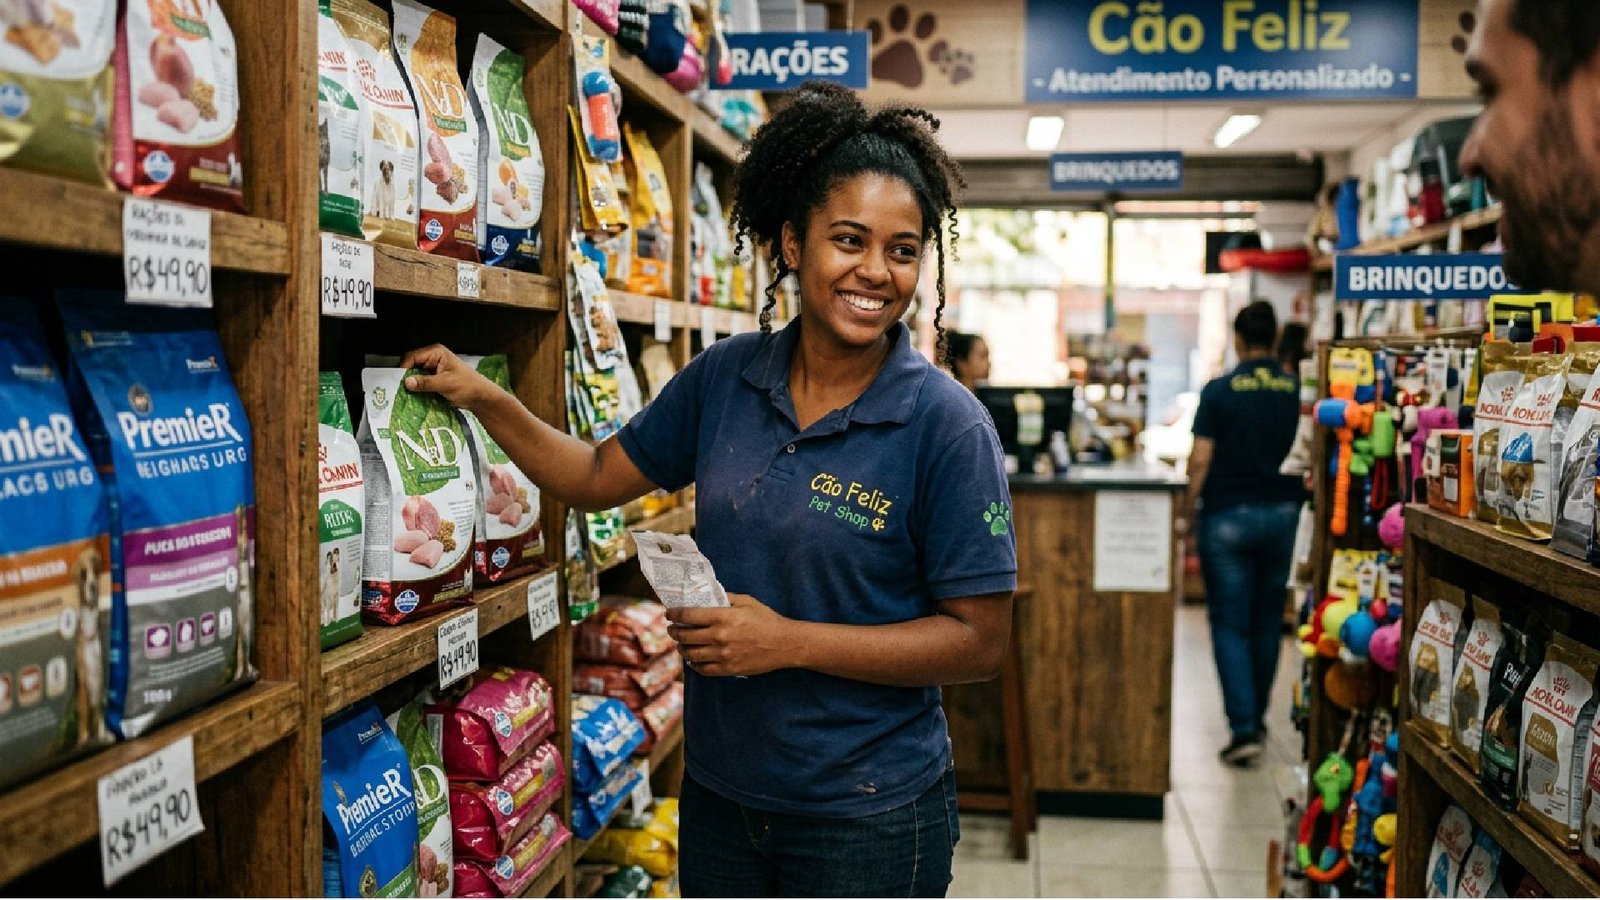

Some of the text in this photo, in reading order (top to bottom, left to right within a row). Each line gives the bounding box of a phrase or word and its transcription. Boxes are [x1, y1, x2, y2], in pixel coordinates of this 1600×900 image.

[1087, 0, 1351, 56] Cão Feliz
[732, 40, 849, 83] RAÇÕES
[1048, 67, 1212, 94] Atendimento
[1216, 62, 1395, 92] Personalizado
[1054, 159, 1179, 184] BRINQUEDOS
[129, 255, 208, 297] R$49,90
[323, 275, 372, 310] R$49,90
[1349, 264, 1519, 296] BRINQUEDO
[117, 402, 244, 450] PremieR
[808, 495, 870, 531] Pet Shop
[811, 472, 893, 516] Cão Feliz
[440, 639, 477, 682] R$49,90
[336, 768, 412, 835] PremieR
